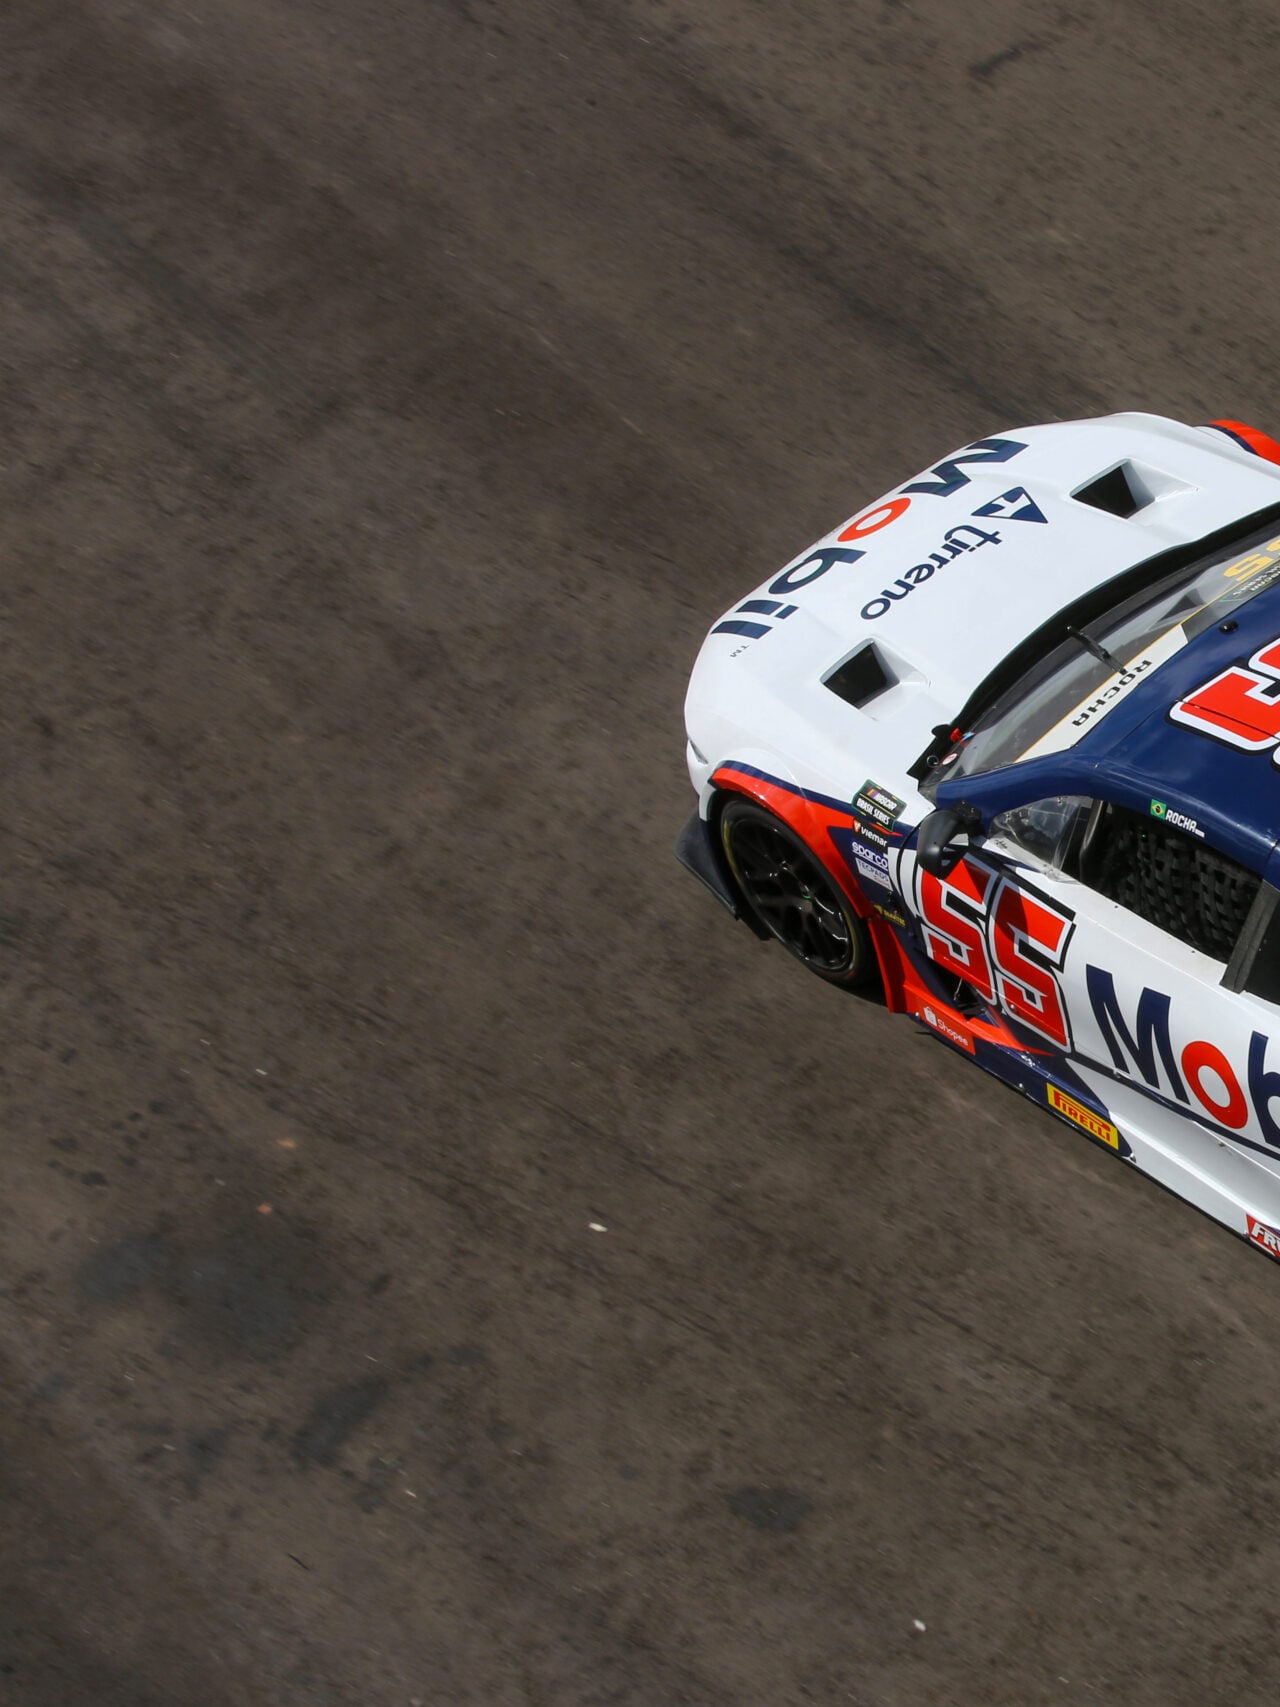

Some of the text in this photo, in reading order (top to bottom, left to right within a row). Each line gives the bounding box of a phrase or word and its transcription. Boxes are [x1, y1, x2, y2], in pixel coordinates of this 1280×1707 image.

[711, 438, 1027, 640] Mobil
[861, 524, 1002, 620] tirreno
[1071, 660, 1152, 726] ROCHA
[856, 797, 890, 825] BRASIL SERIES
[1165, 809, 1198, 833] ROCHA
[860, 826, 888, 847] viemar
[851, 841, 888, 870] sparco
[857, 859, 890, 882] TECPADS
[916, 853, 1074, 1053] 55
[937, 1018, 969, 1046] Shopee
[1053, 1089, 1111, 1142] PIRELLI
